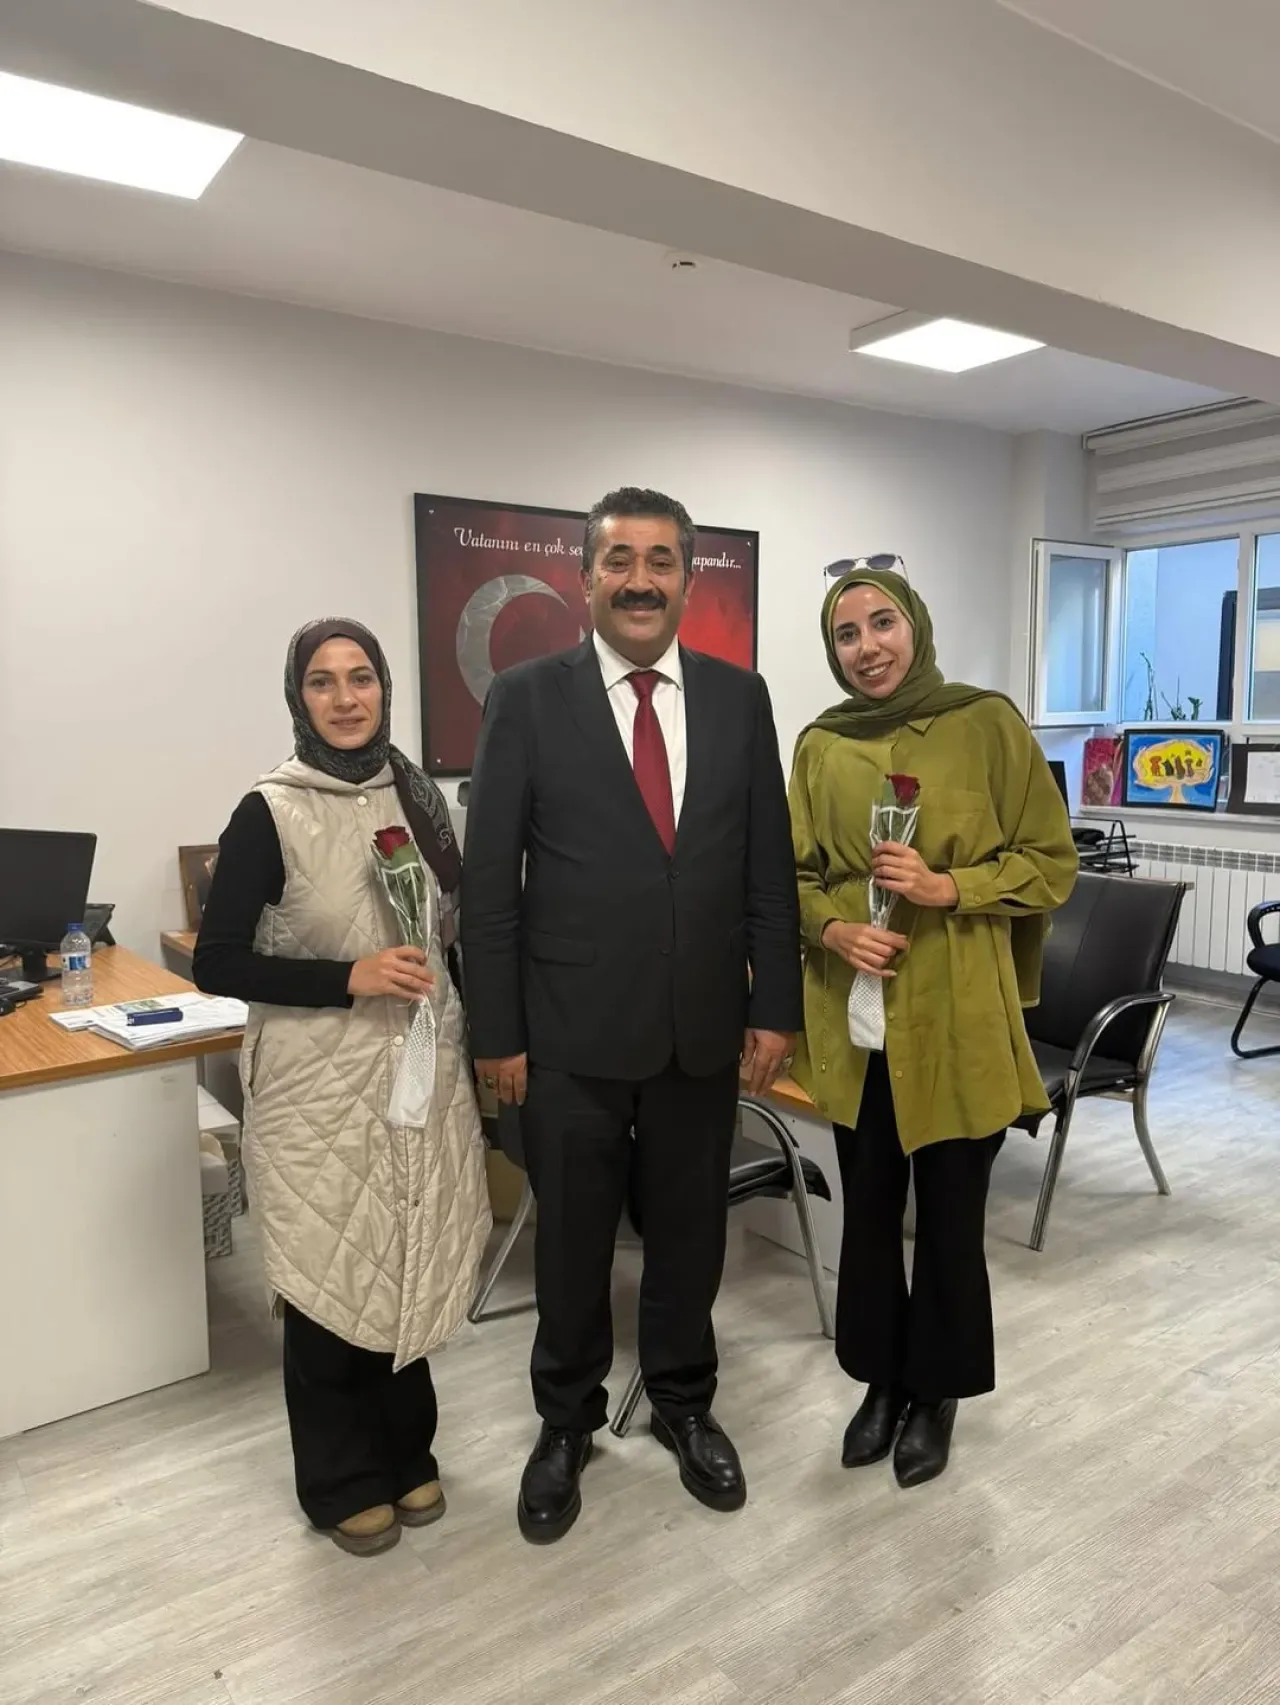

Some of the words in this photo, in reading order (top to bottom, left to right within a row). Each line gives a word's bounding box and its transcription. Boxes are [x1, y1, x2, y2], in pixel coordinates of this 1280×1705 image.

[454, 527, 519, 551] Vatanını
[524, 541, 541, 553] en
[544, 537, 565, 557] çok
